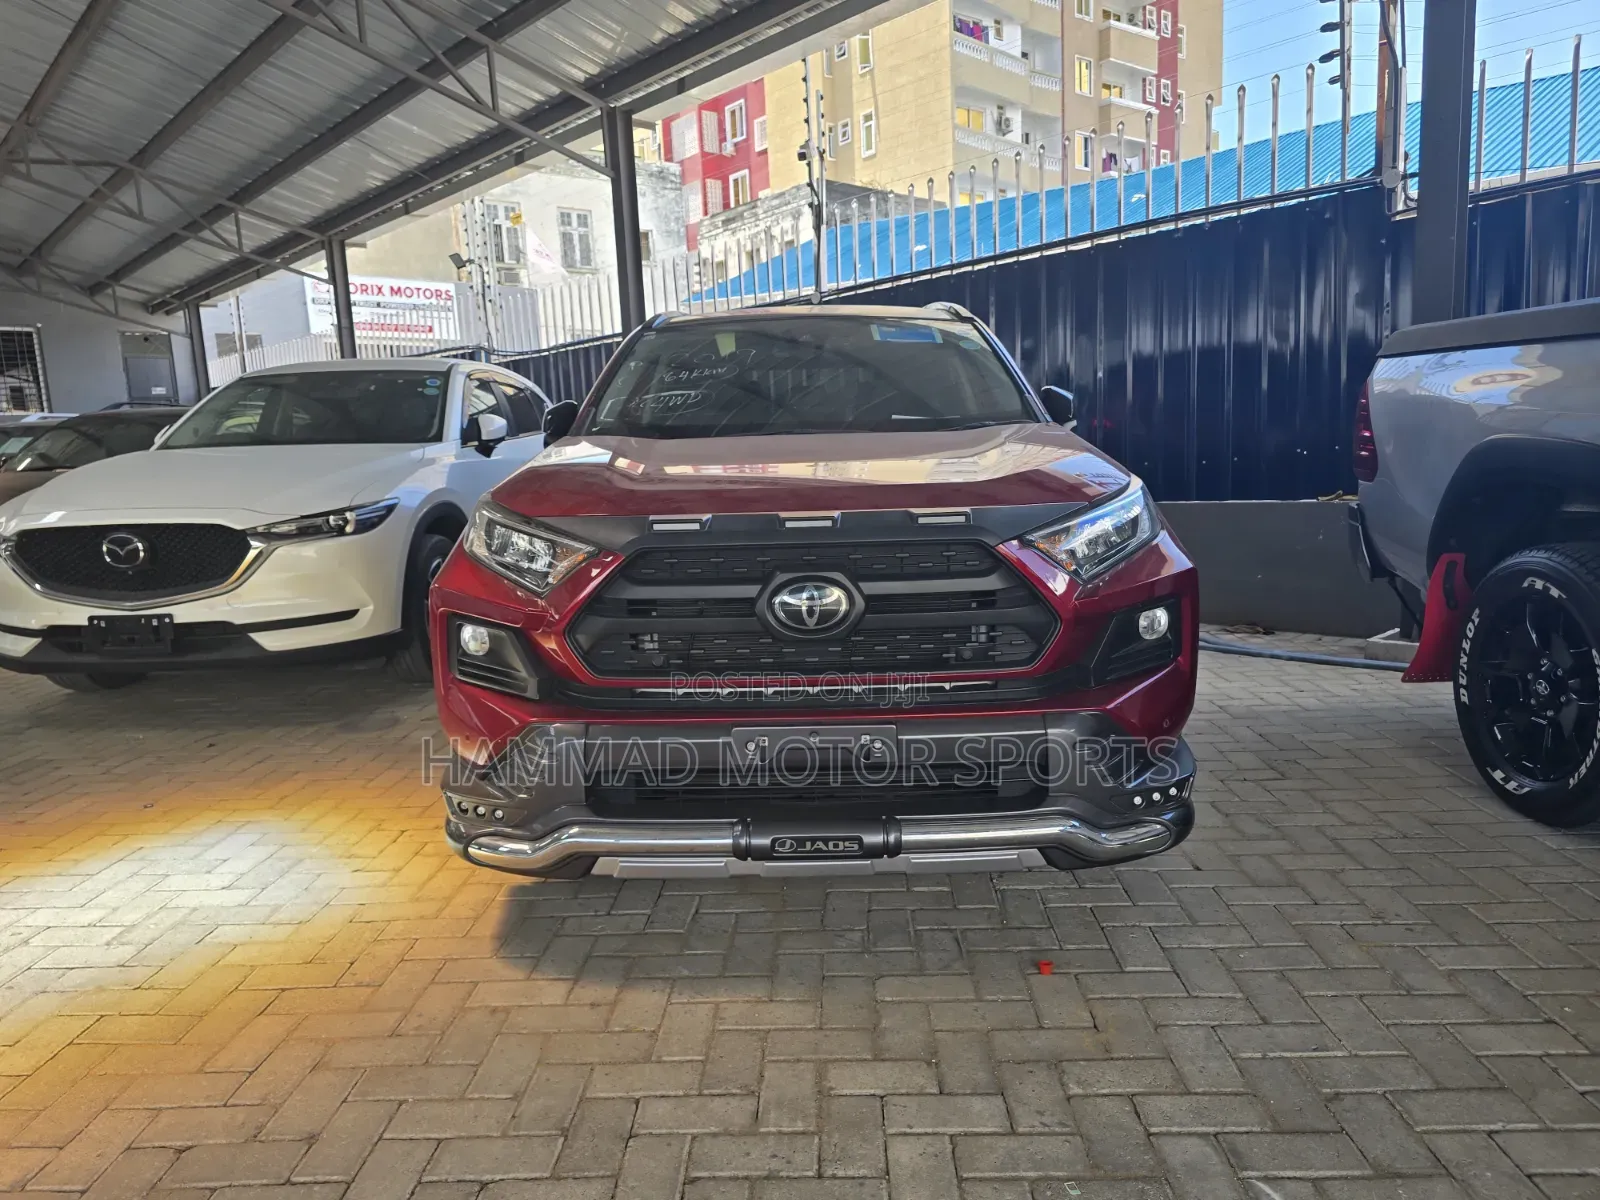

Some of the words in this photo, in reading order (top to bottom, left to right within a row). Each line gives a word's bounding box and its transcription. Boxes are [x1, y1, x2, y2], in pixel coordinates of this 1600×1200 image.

[390, 285, 453, 301] MOTORS
[1521, 576, 1567, 599] AT
[1459, 607, 1481, 705] DUNLOP
[797, 840, 860, 851] JAOS
